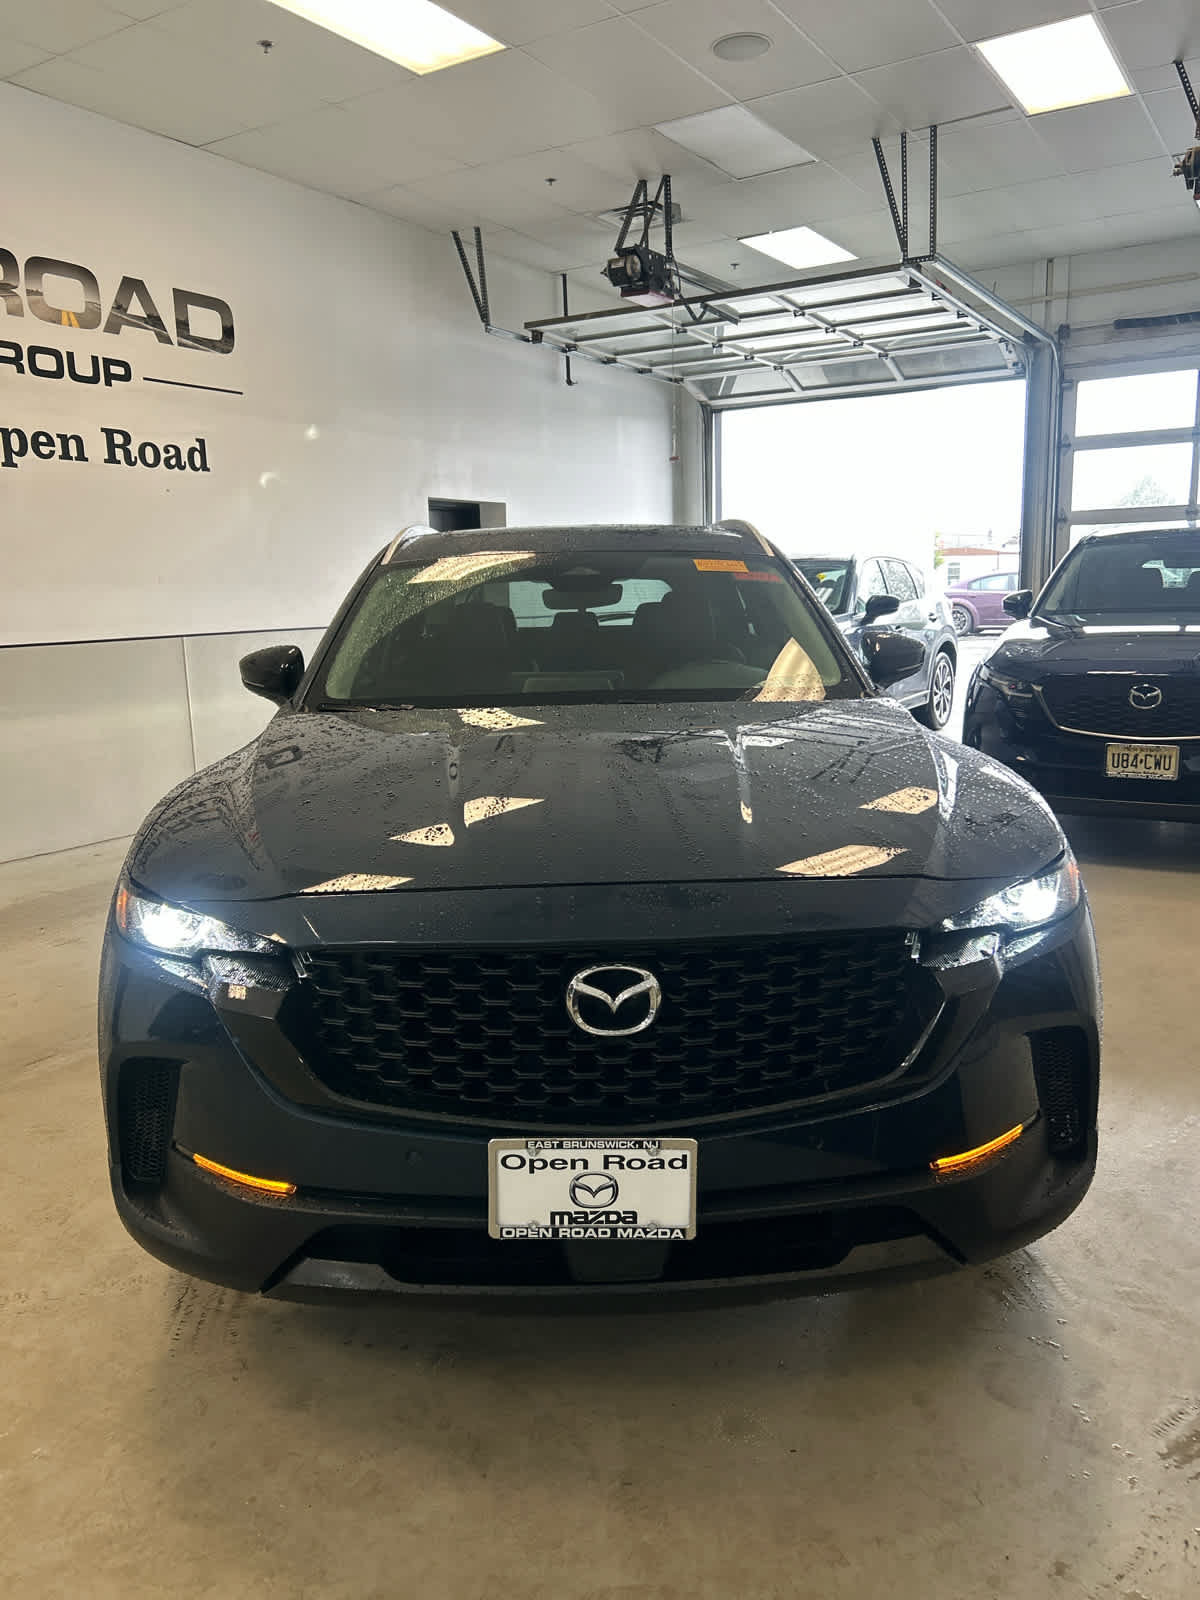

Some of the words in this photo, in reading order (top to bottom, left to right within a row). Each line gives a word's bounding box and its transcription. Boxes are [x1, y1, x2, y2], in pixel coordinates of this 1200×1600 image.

[100, 427, 210, 472] Road
[527, 1141, 559, 1149] EAST
[562, 1141, 638, 1149] BRUNSWICK,
[642, 1141, 659, 1149] NJ
[500, 1154, 589, 1174] Open
[603, 1154, 688, 1170] Road
[550, 1210, 638, 1225] mazda
[502, 1229, 552, 1238] OPEN
[558, 1228, 611, 1238] ROAD
[617, 1228, 684, 1239] MAZDA
